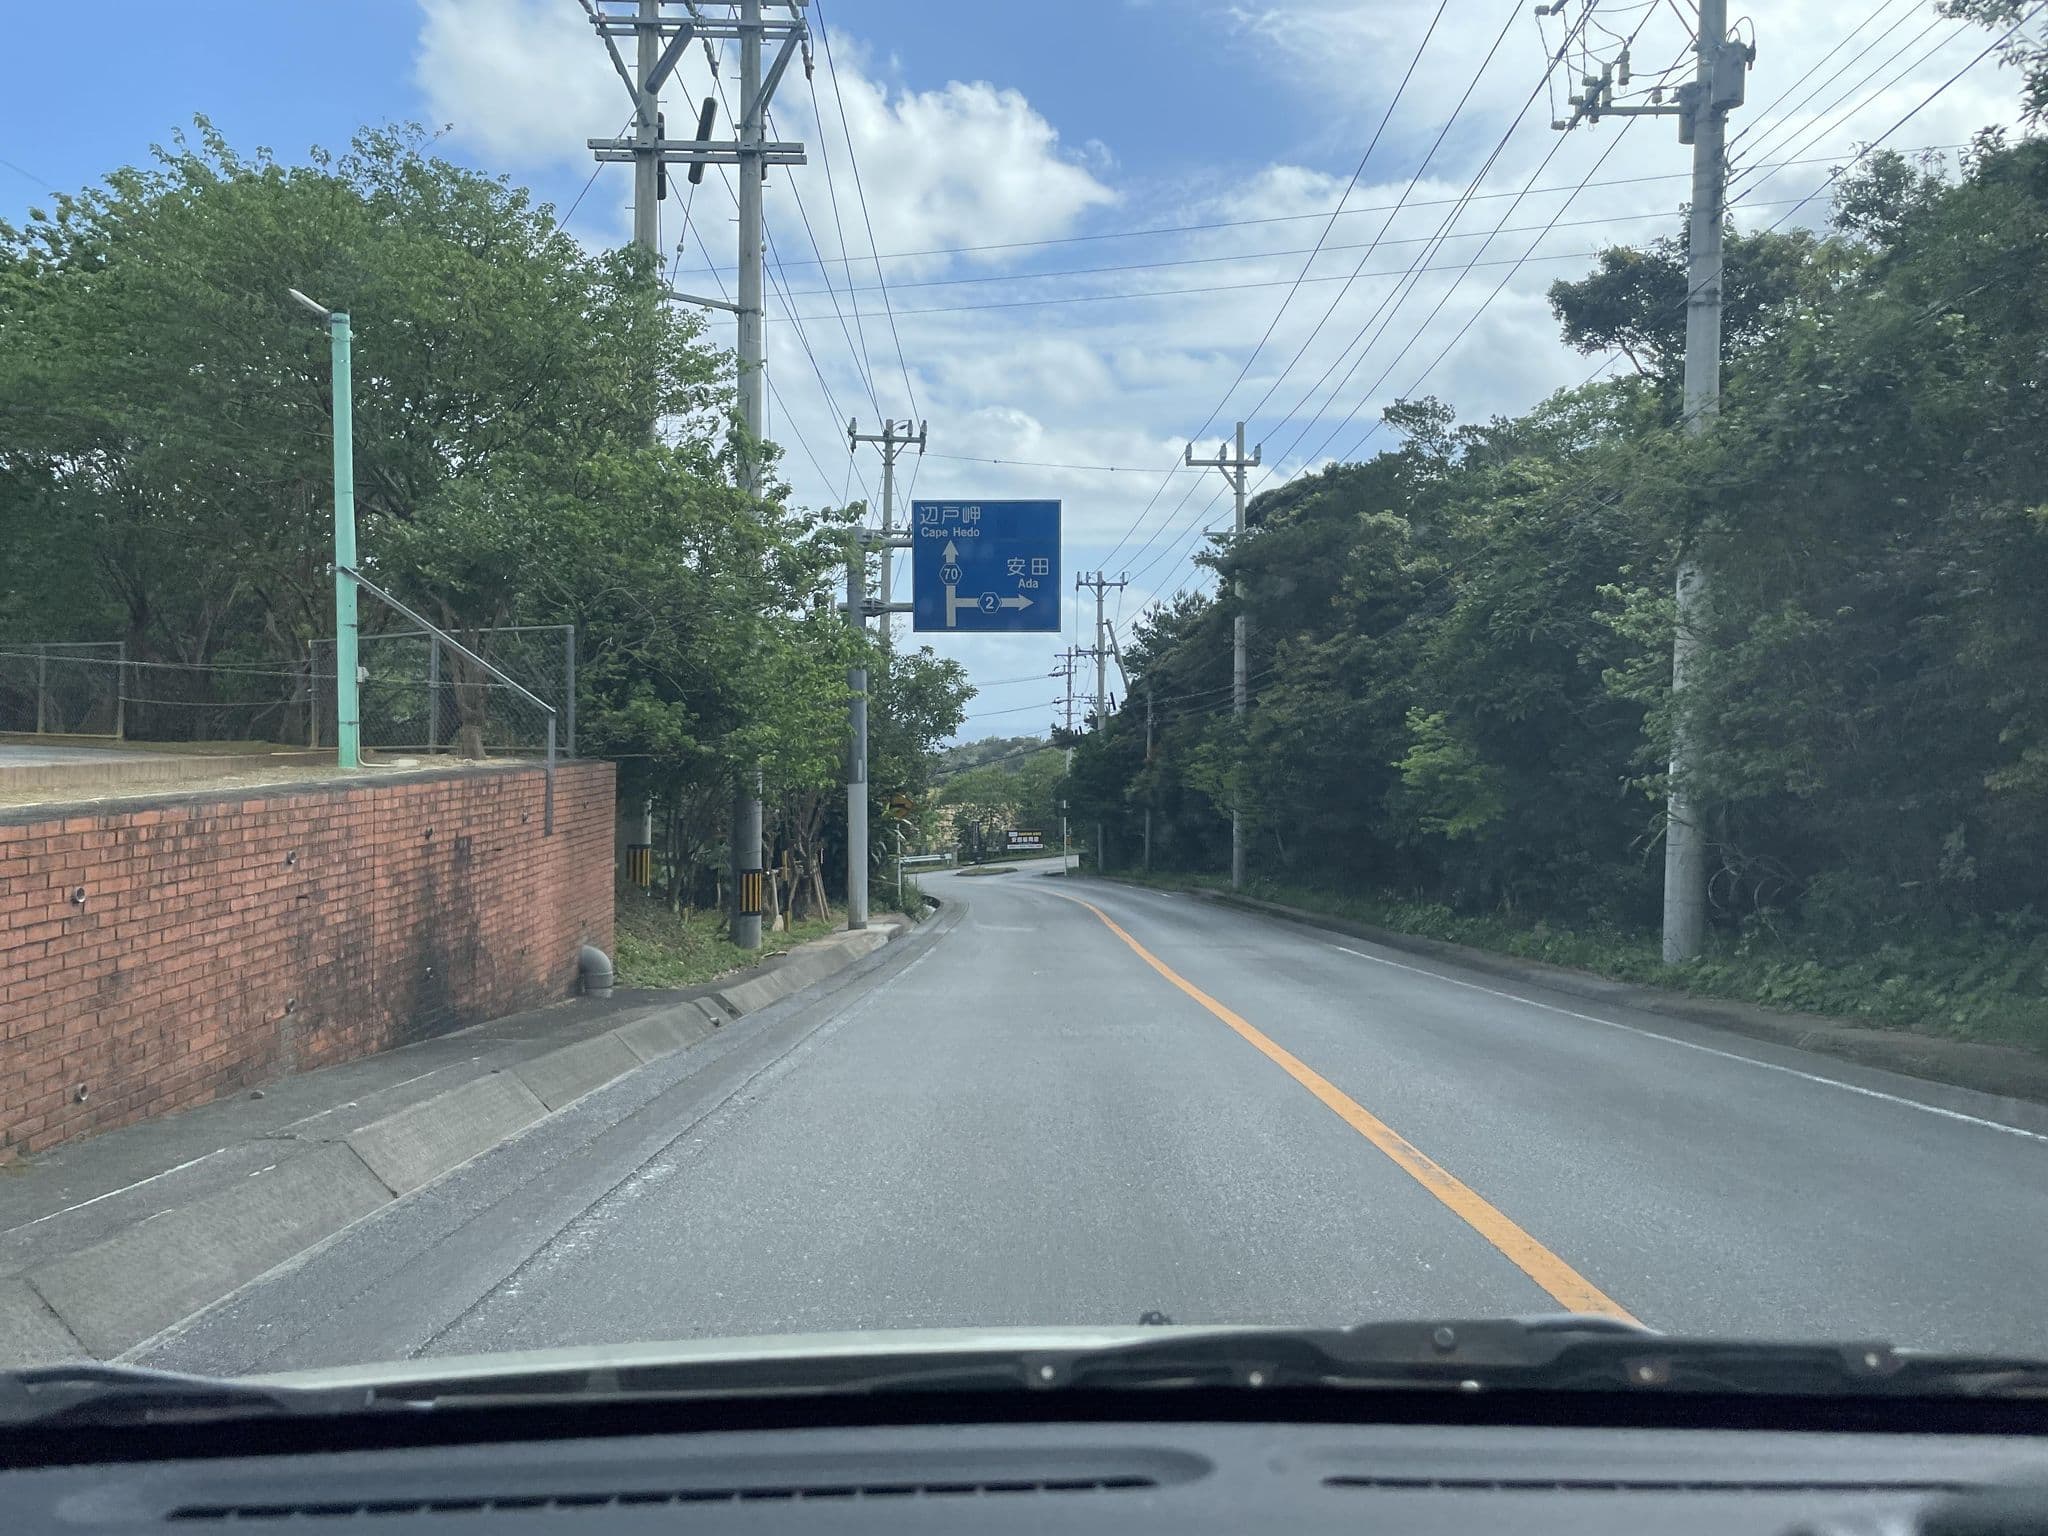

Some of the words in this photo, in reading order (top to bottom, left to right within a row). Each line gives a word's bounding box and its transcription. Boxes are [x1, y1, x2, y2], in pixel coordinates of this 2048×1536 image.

[920, 506, 980, 525] 辺戸岬
[921, 527, 948, 539] Cape
[953, 527, 980, 537] Hedo
[1007, 557, 1049, 576] 安田
[944, 568, 958, 580] 70
[1018, 578, 1039, 589] Ada
[985, 597, 994, 609] 2
